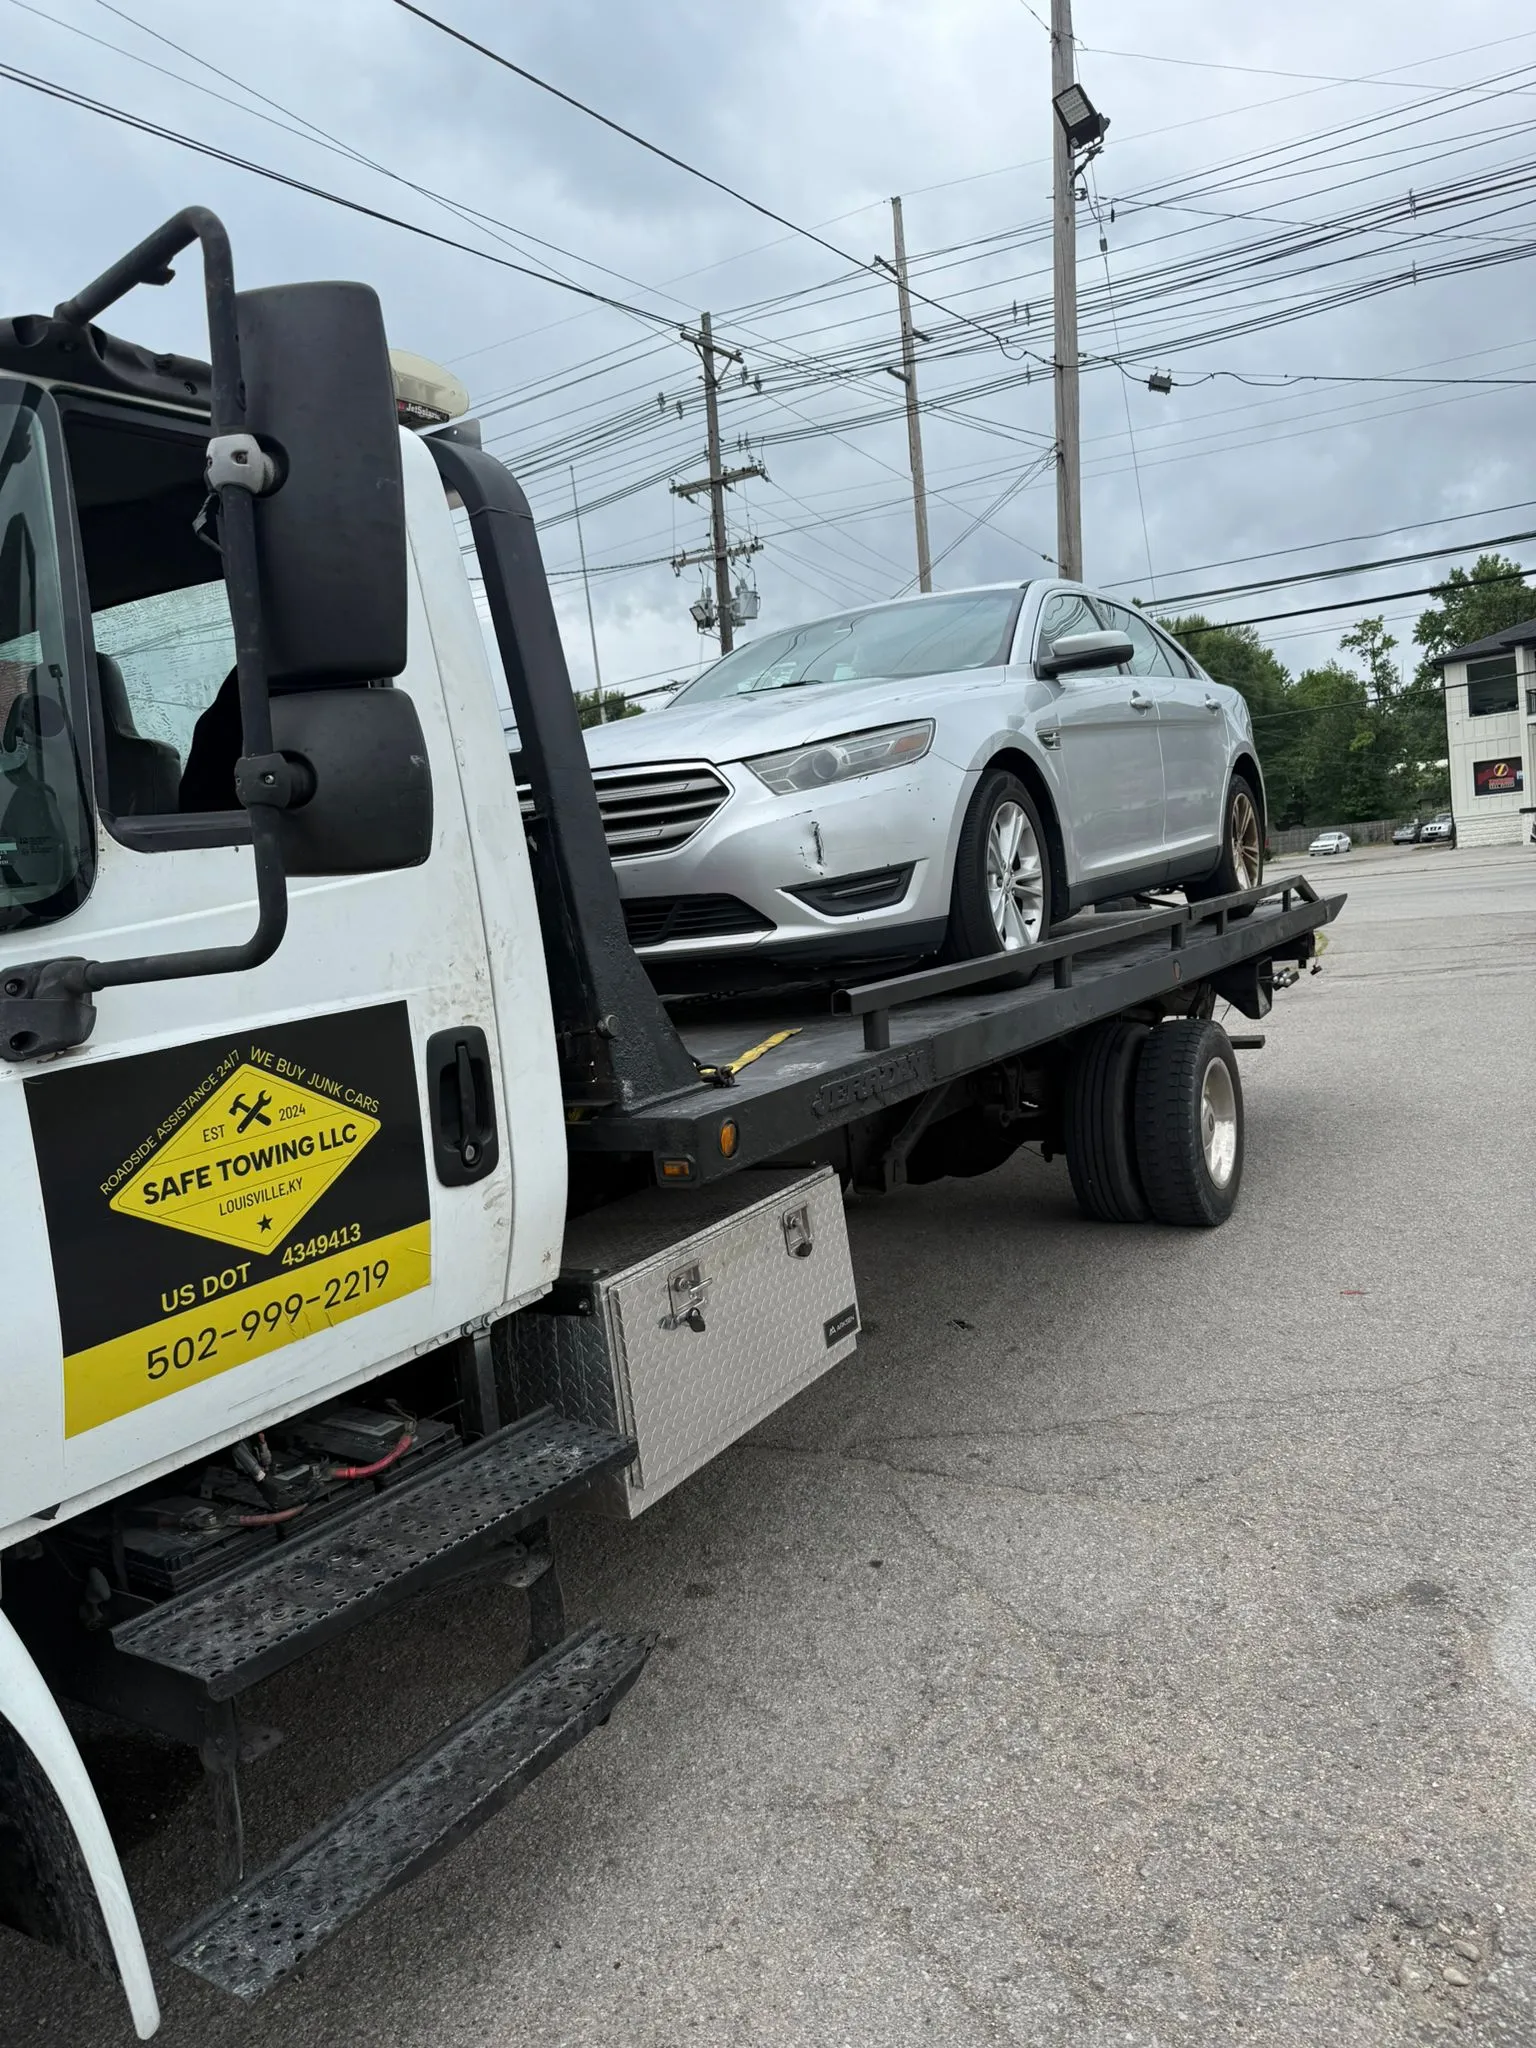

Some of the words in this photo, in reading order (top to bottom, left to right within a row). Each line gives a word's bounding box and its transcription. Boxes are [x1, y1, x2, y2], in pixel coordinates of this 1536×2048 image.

[250, 1045, 275, 1068] WE
[276, 1057, 306, 1081] BUY
[307, 1072, 344, 1098] JUNK
[344, 1088, 380, 1113] CARS
[99, 1135, 158, 1195] ROADSIDE
[156, 1073, 219, 1140] ASSISTANCE
[216, 1049, 241, 1077] 24/7
[202, 1124, 226, 1143] EST
[278, 1103, 306, 1122] 2024
[142, 1165, 212, 1206] SAFE
[215, 1135, 315, 1182] TOWING
[318, 1123, 358, 1151] LLC
[281, 1222, 362, 1266] 4349413
[147, 1259, 390, 1380] 502-999-2219
[161, 1283, 196, 1313] US
[202, 1262, 251, 1298] DOT
